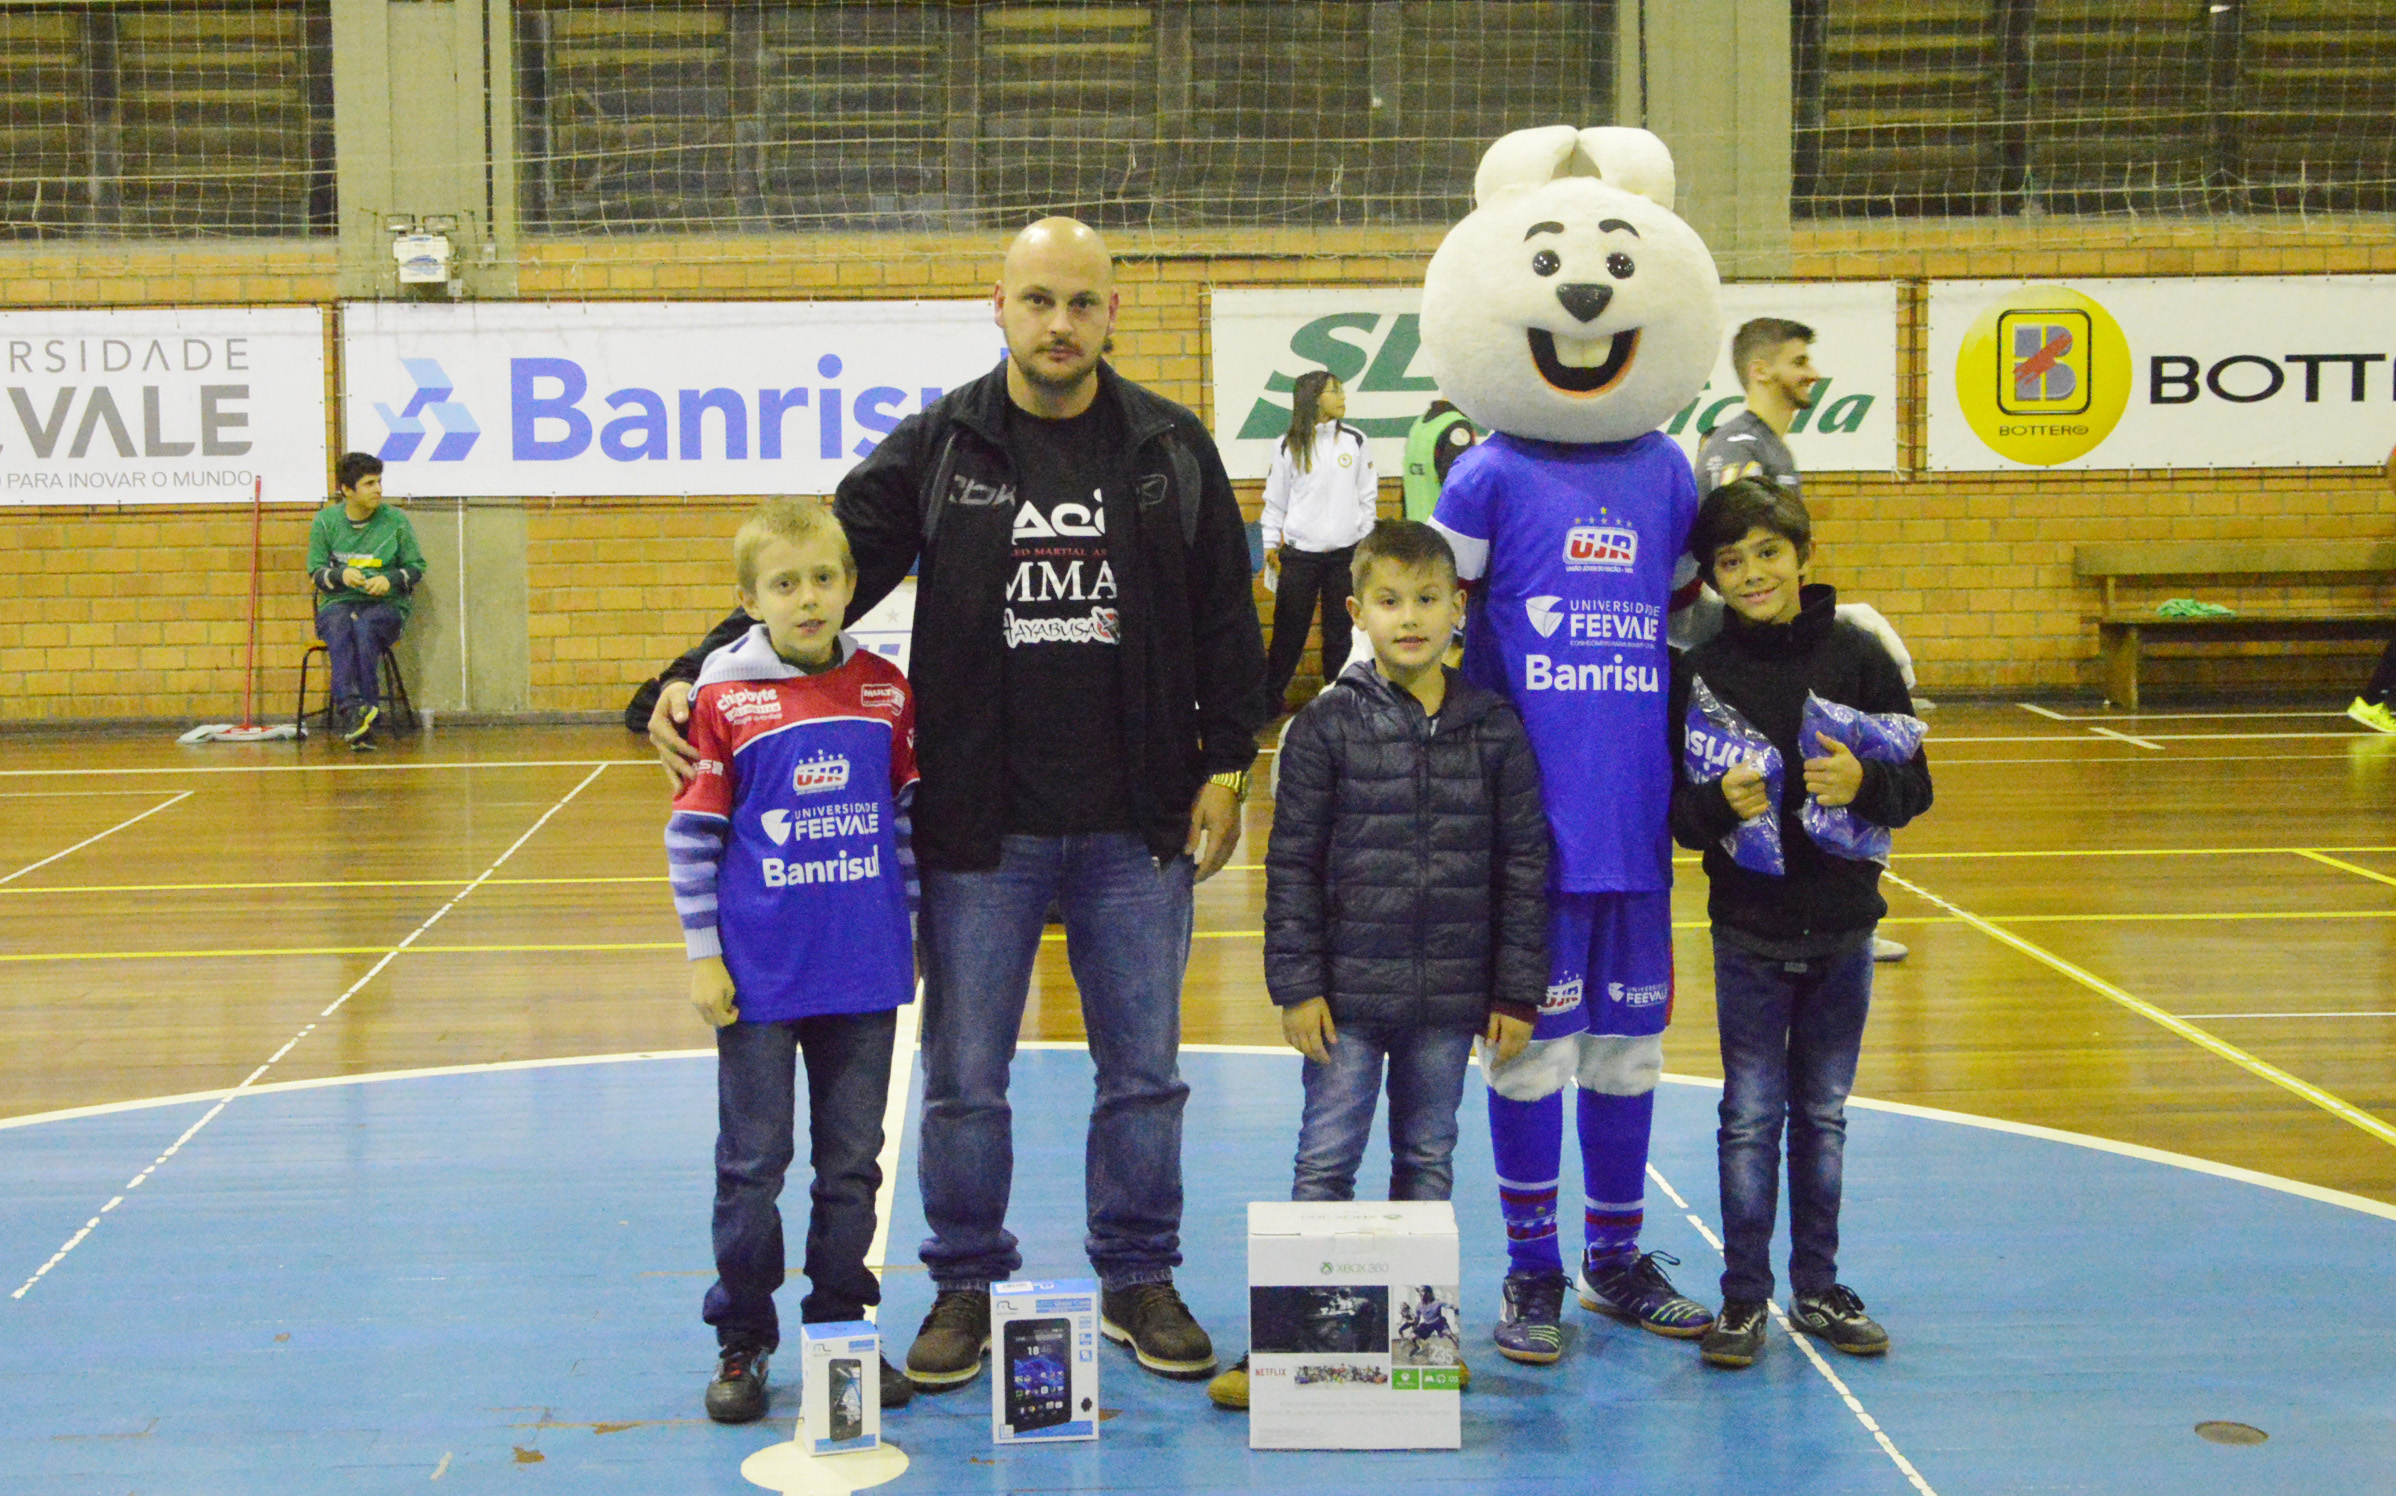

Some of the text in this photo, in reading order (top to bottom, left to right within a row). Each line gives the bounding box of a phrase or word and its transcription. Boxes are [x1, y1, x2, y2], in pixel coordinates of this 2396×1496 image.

[2150, 353, 2396, 404] BOTT
[0, 384, 253, 459] VALE
[510, 353, 1008, 462] Banris
[8, 470, 254, 489] PARA INOVAR O MUNDO
[1034, 547, 1087, 557] MARTIAL
[1006, 560, 1117, 602] MMA
[1570, 613, 1659, 641] FEEVALE
[795, 814, 878, 841] FEEVALE
[763, 844, 880, 888] Banrisul
[1336, 1263, 1389, 1273] XBOX 360
[1255, 1368, 1287, 1377] NETFLIX
